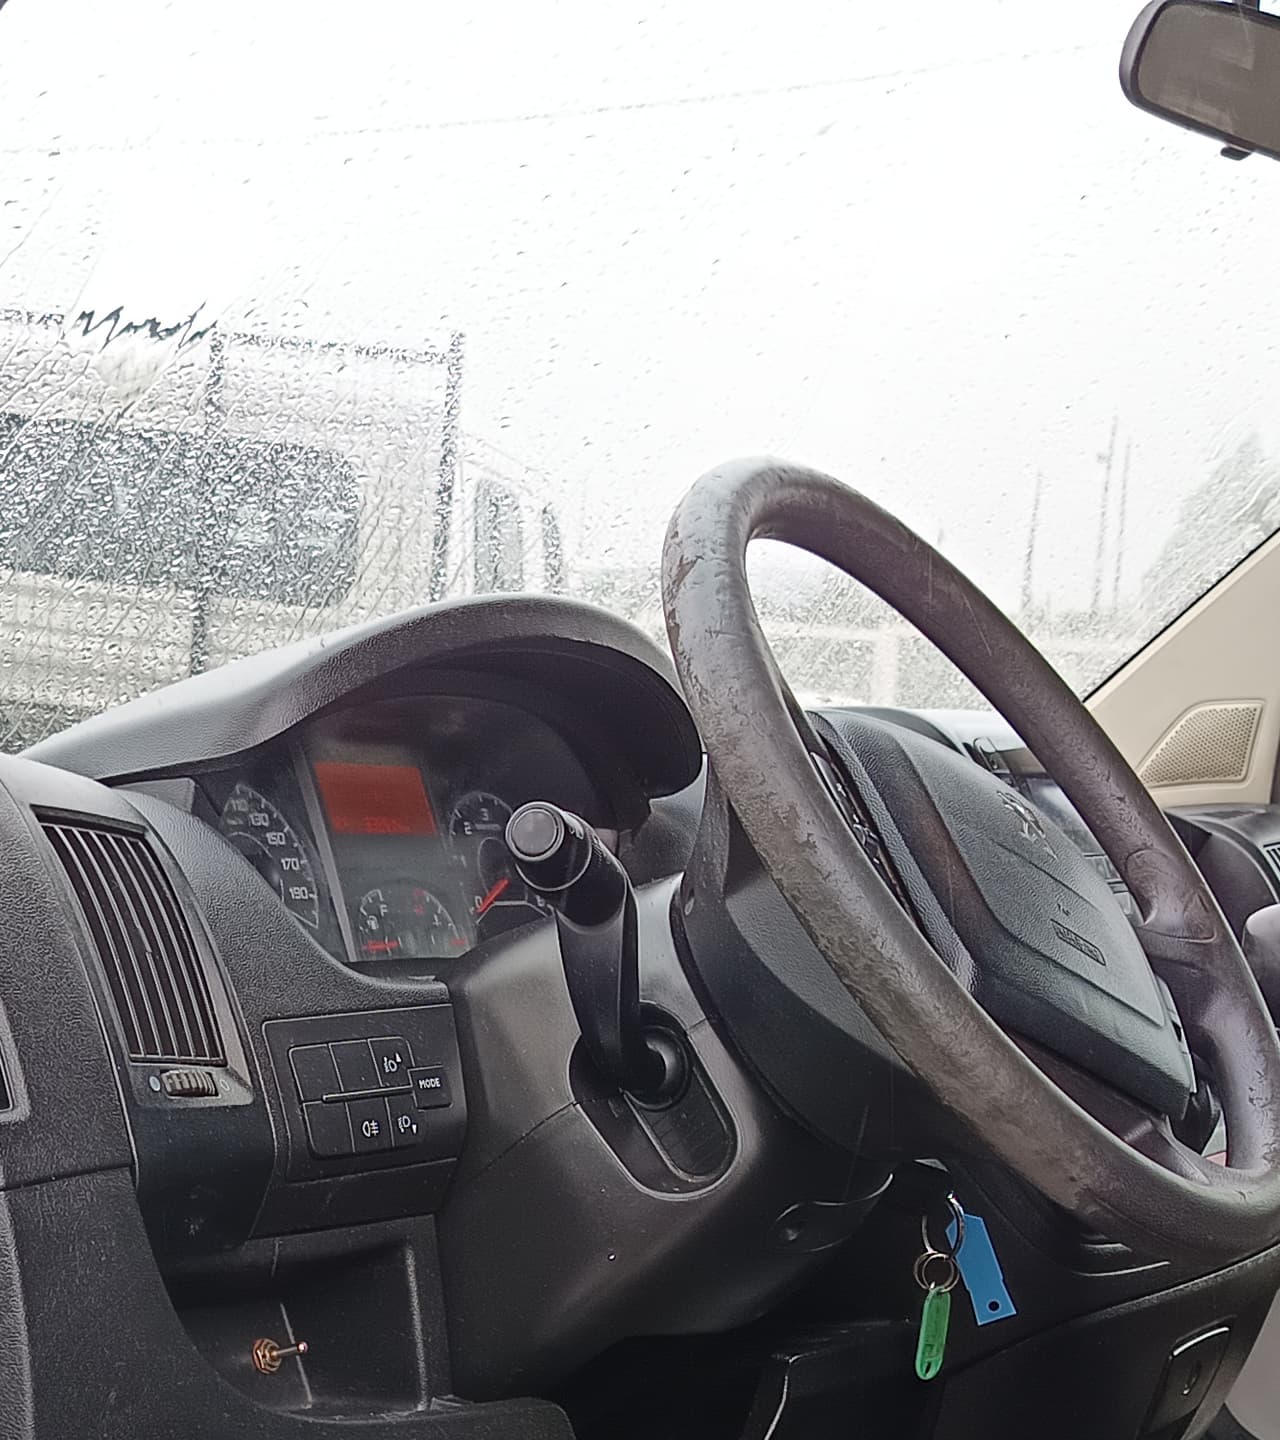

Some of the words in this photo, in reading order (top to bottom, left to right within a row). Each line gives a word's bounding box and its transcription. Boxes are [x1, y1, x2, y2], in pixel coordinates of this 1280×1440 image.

[249, 813, 269, 826] 130
[481, 808, 489, 820] 3
[463, 821, 472, 834] 2
[266, 832, 286, 845] 150
[281, 858, 300, 870] 170
[289, 887, 308, 899] 190
[381, 904, 388, 916] F
[418, 1077, 441, 1089] MODE
